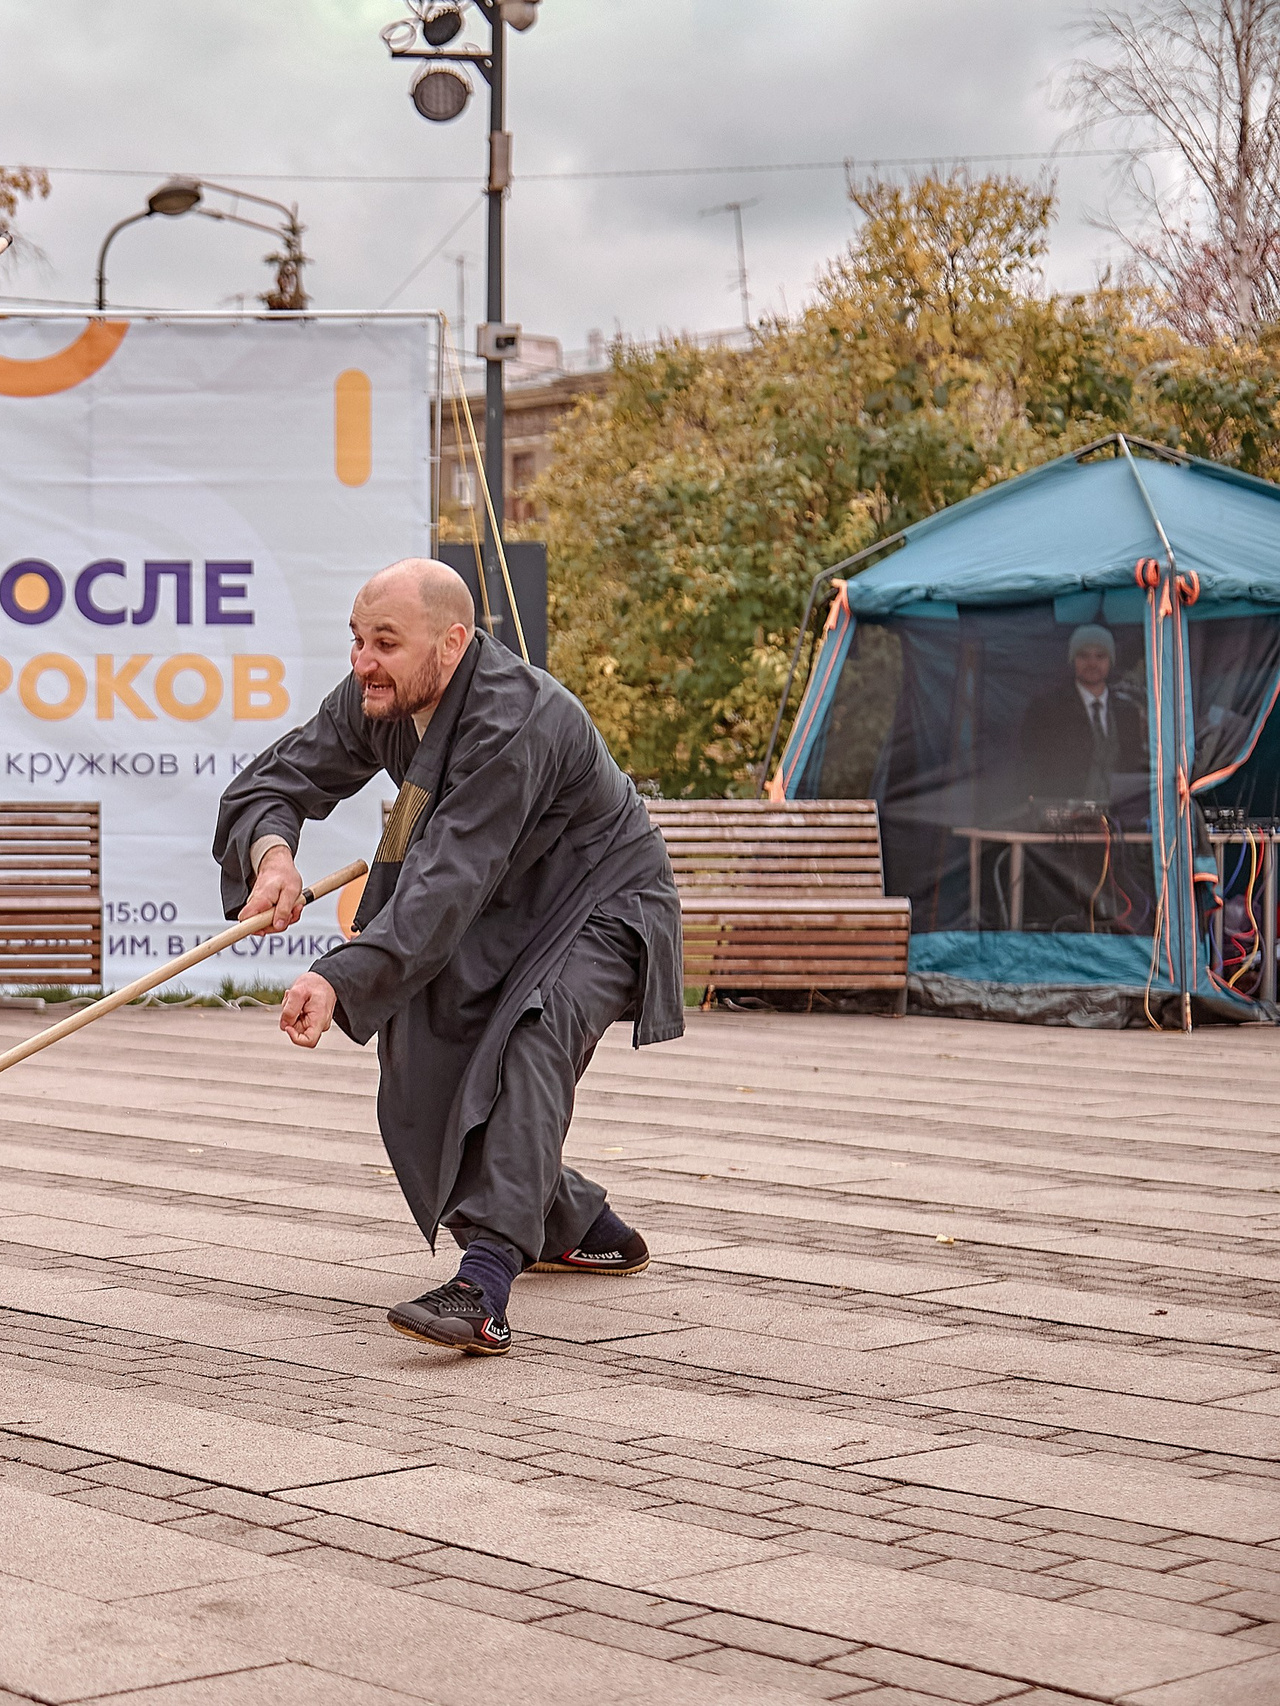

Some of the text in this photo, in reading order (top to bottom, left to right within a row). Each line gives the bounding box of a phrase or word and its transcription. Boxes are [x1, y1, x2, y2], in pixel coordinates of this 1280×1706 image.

[7, 752, 179, 783] кружков
[195, 753, 215, 775] и
[106, 901, 177, 922] 15:00
[109, 935, 158, 956] ИМ.
